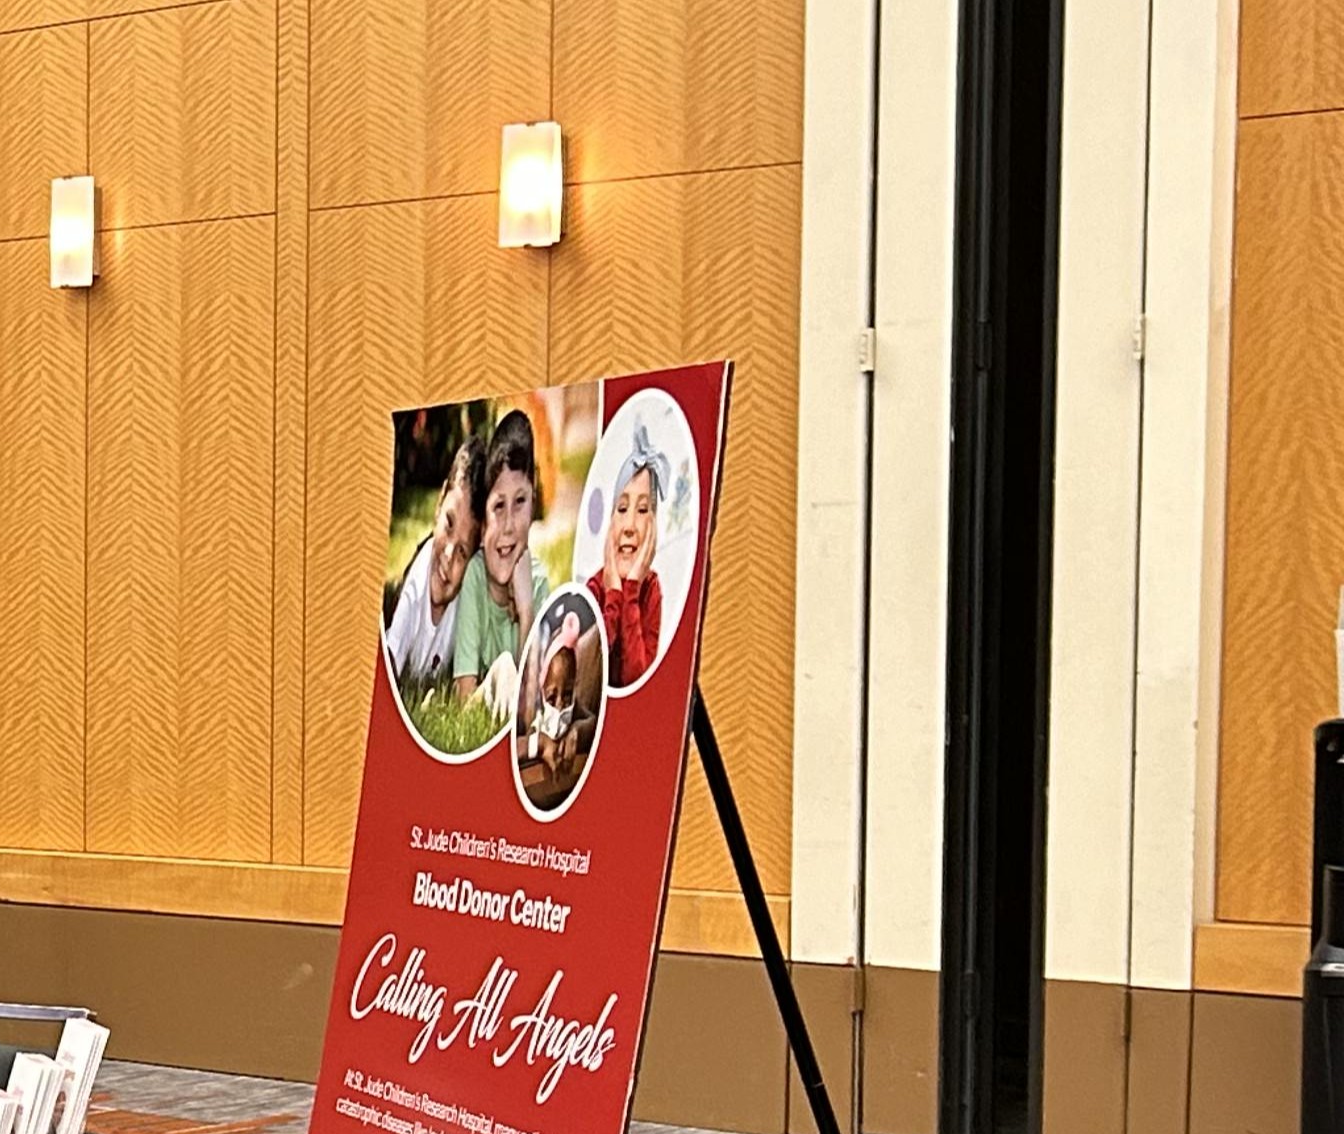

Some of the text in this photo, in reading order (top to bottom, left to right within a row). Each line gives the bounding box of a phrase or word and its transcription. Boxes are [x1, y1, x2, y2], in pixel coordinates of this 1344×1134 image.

[423, 828, 449, 852] Jude
[449, 831, 497, 861] Children's
[496, 838, 545, 868] Research
[544, 845, 592, 878] Hospital
[413, 871, 571, 933] Blood Donor Center
[350, 933, 618, 1105] Calling All Angels
[336, 1097, 383, 1127] catastrophic
[421, 1093, 458, 1123] Research
